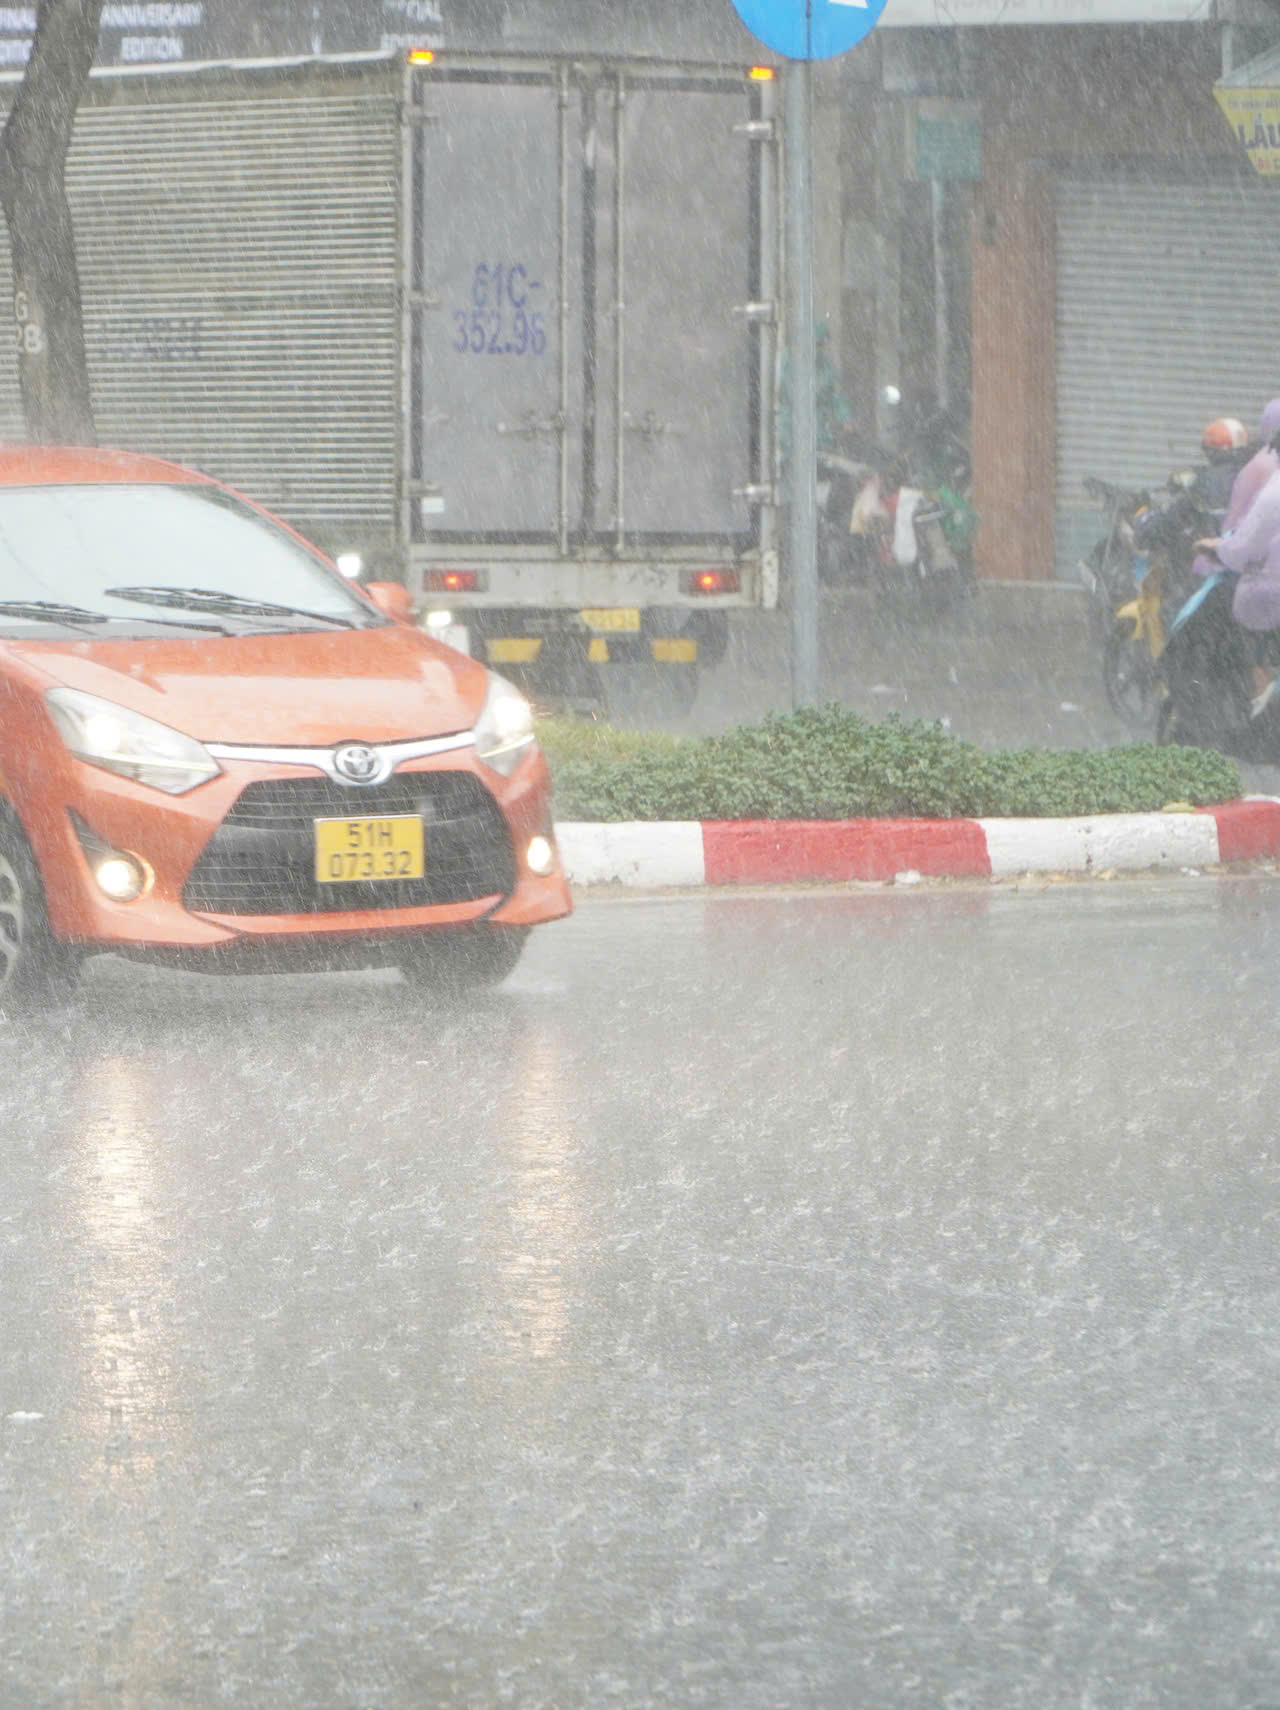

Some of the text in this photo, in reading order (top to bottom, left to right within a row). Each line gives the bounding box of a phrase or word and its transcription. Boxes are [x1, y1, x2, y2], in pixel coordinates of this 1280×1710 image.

[100, 3, 202, 27] ANNIVERSARY
[122, 36, 184, 60] EDITION
[348, 822, 393, 848] 51H
